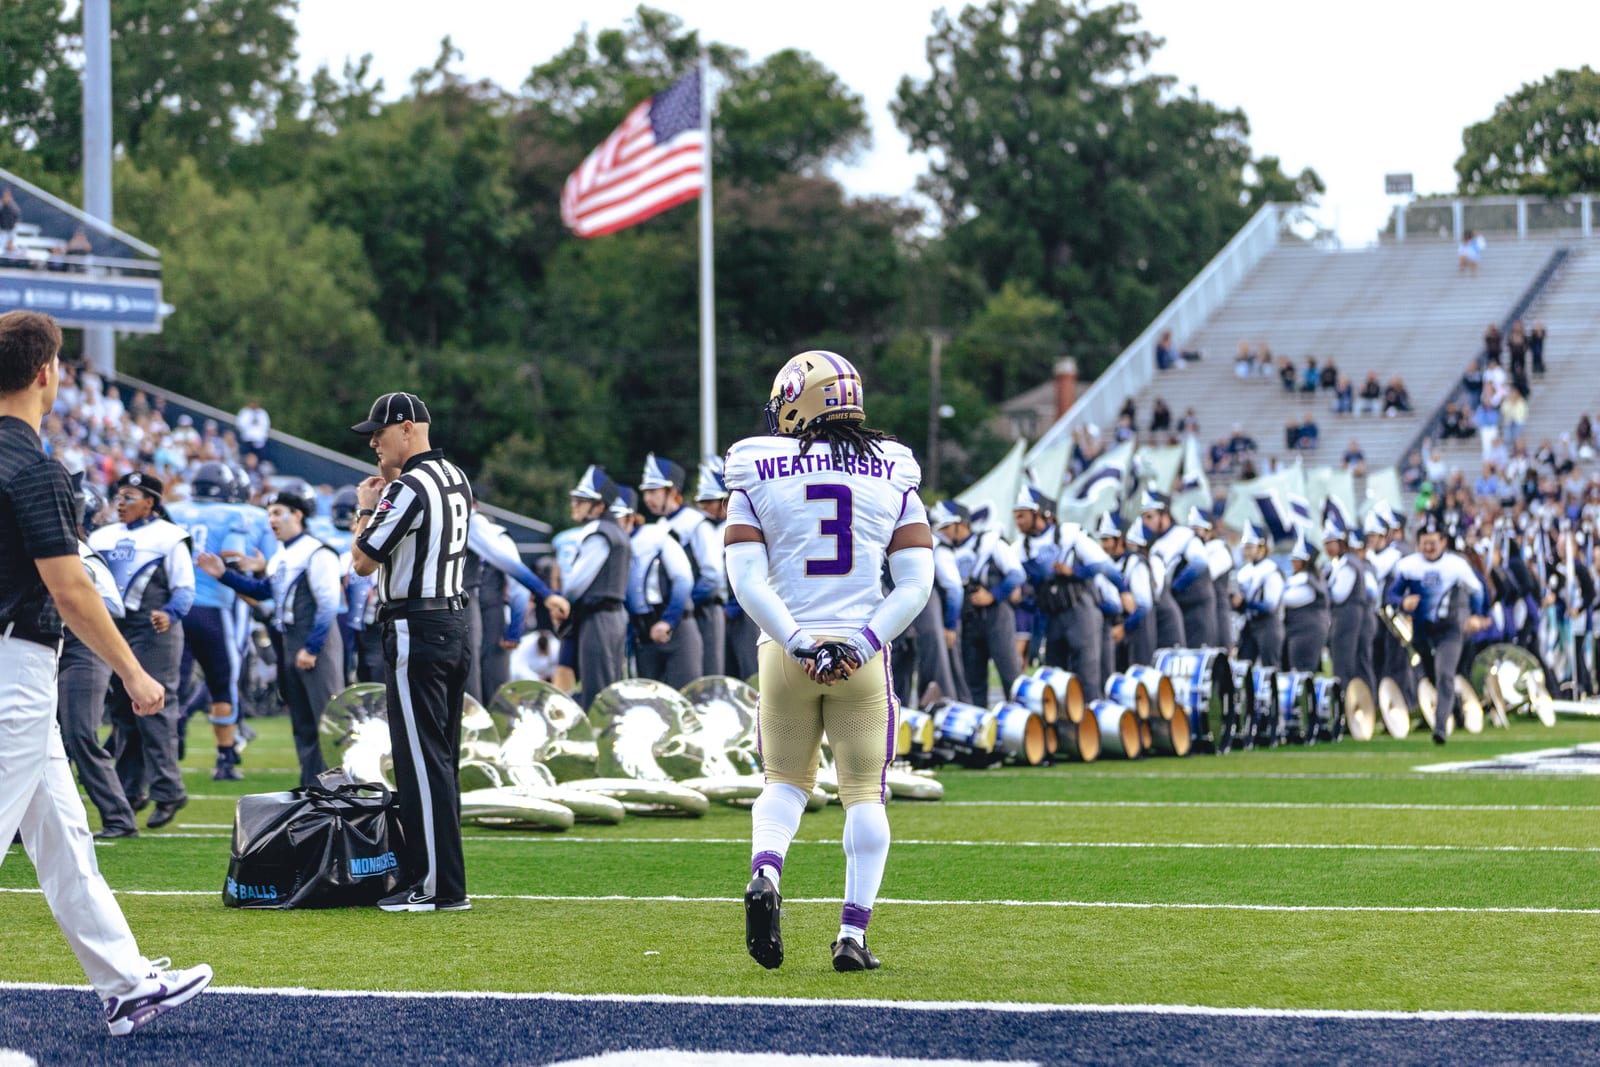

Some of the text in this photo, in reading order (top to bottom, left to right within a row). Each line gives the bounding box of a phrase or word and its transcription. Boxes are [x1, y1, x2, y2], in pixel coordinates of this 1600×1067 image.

[396, 413, 404, 421] S
[447, 492, 468, 555] B
[803, 482, 855, 577] 3
[239, 884, 278, 900] BALLS
